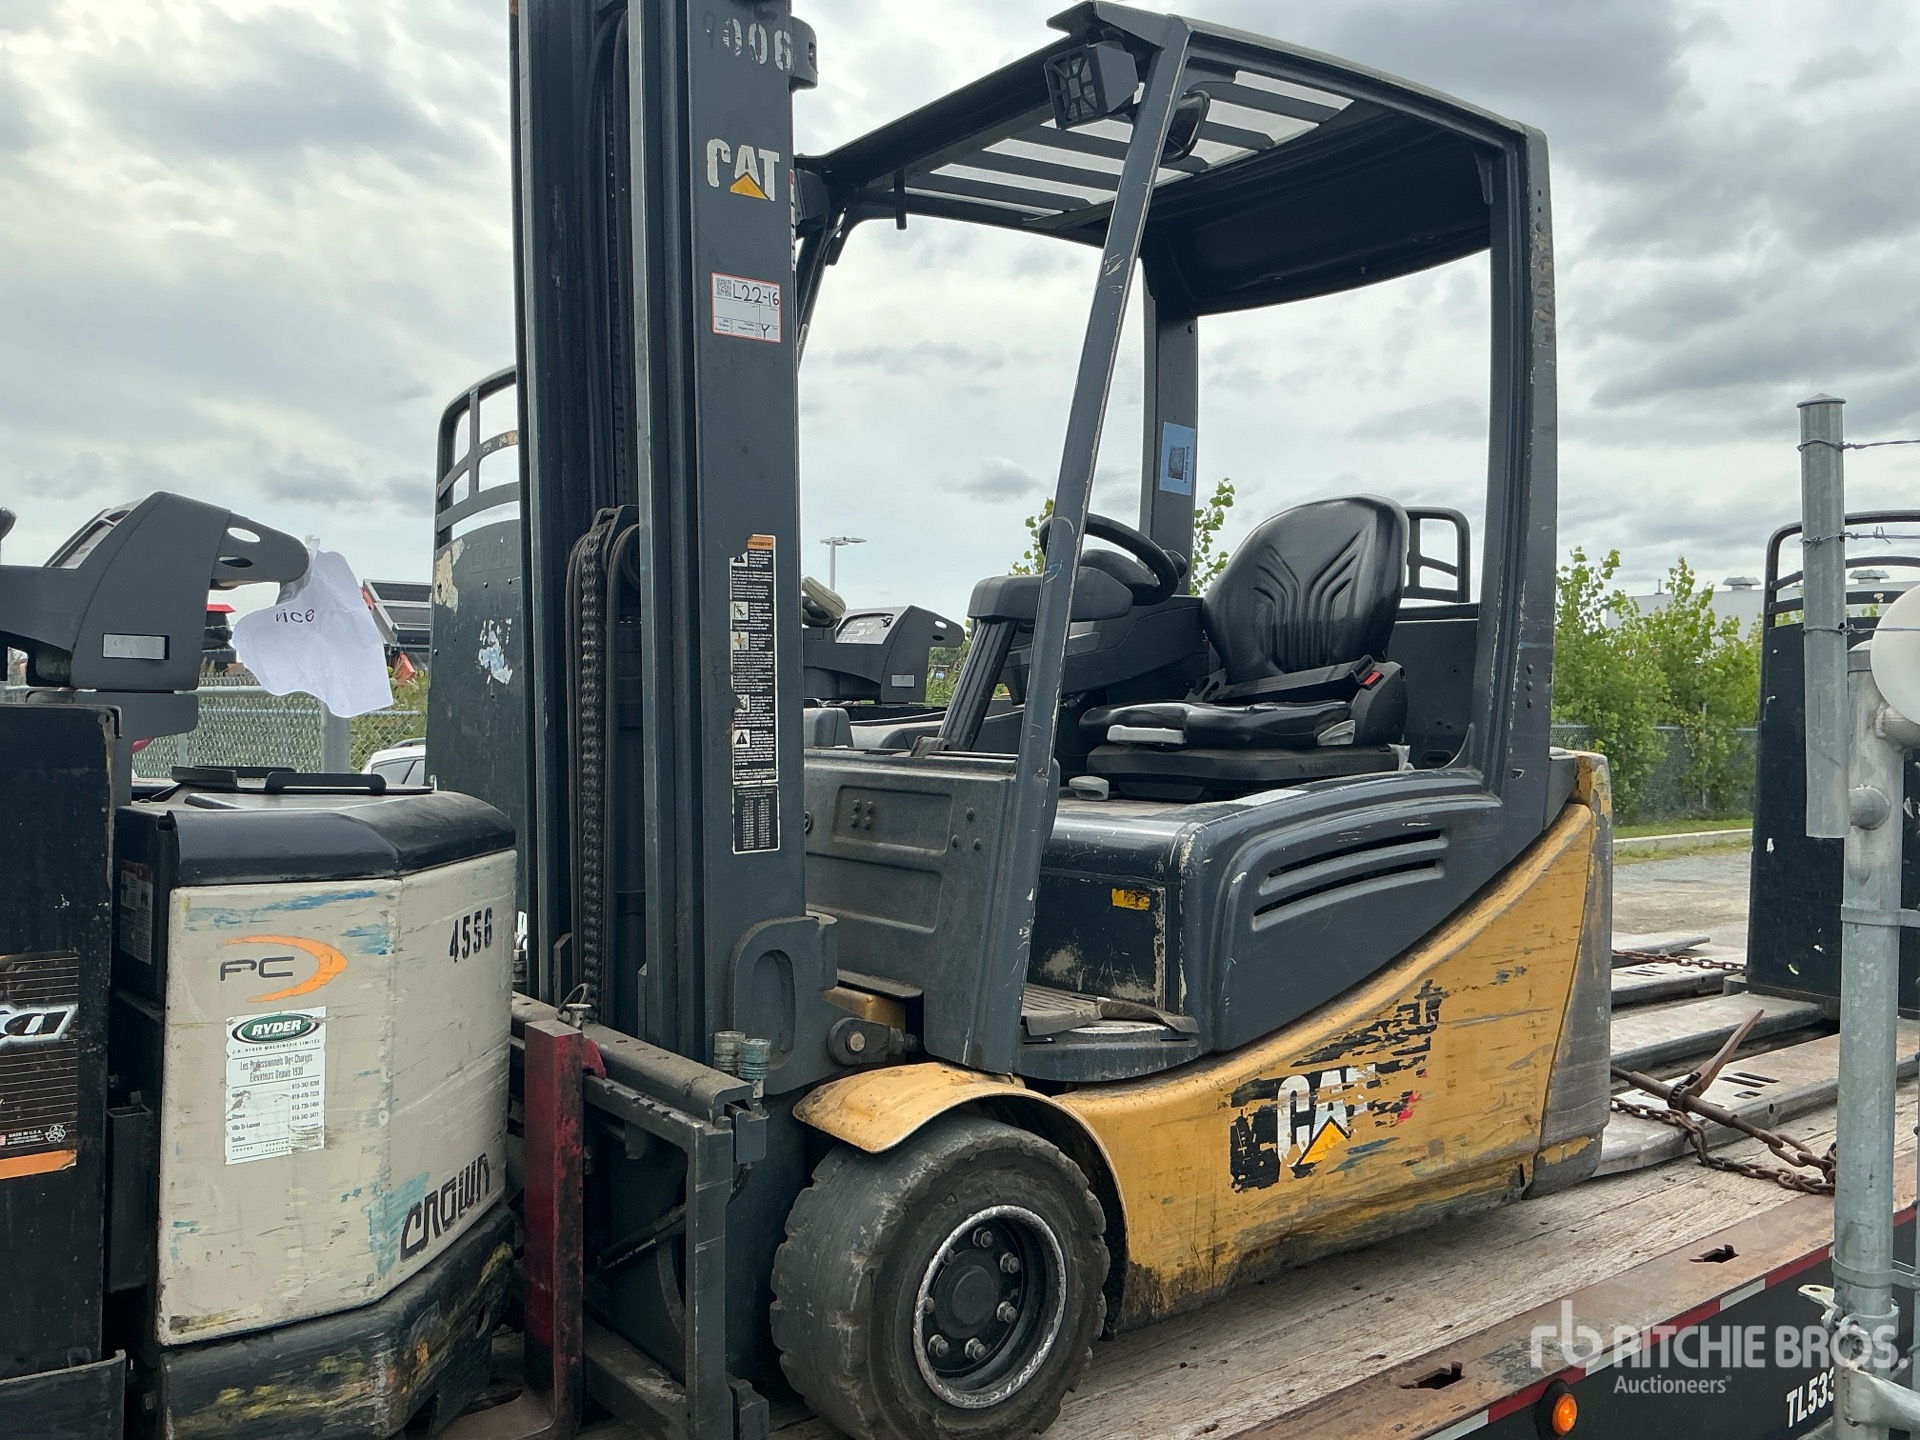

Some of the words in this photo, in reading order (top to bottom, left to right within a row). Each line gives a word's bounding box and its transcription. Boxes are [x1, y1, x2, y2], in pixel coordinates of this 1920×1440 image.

[706, 138, 780, 201] CAT
[733, 283, 780, 308] L22-16
[449, 906, 493, 963] 4556
[220, 956, 295, 981] PC
[251, 1020, 302, 1036] RYDER
[240, 1060, 249, 1071] Les
[275, 1069, 291, 1080] Depuis
[400, 1152, 490, 1263] CROWN
